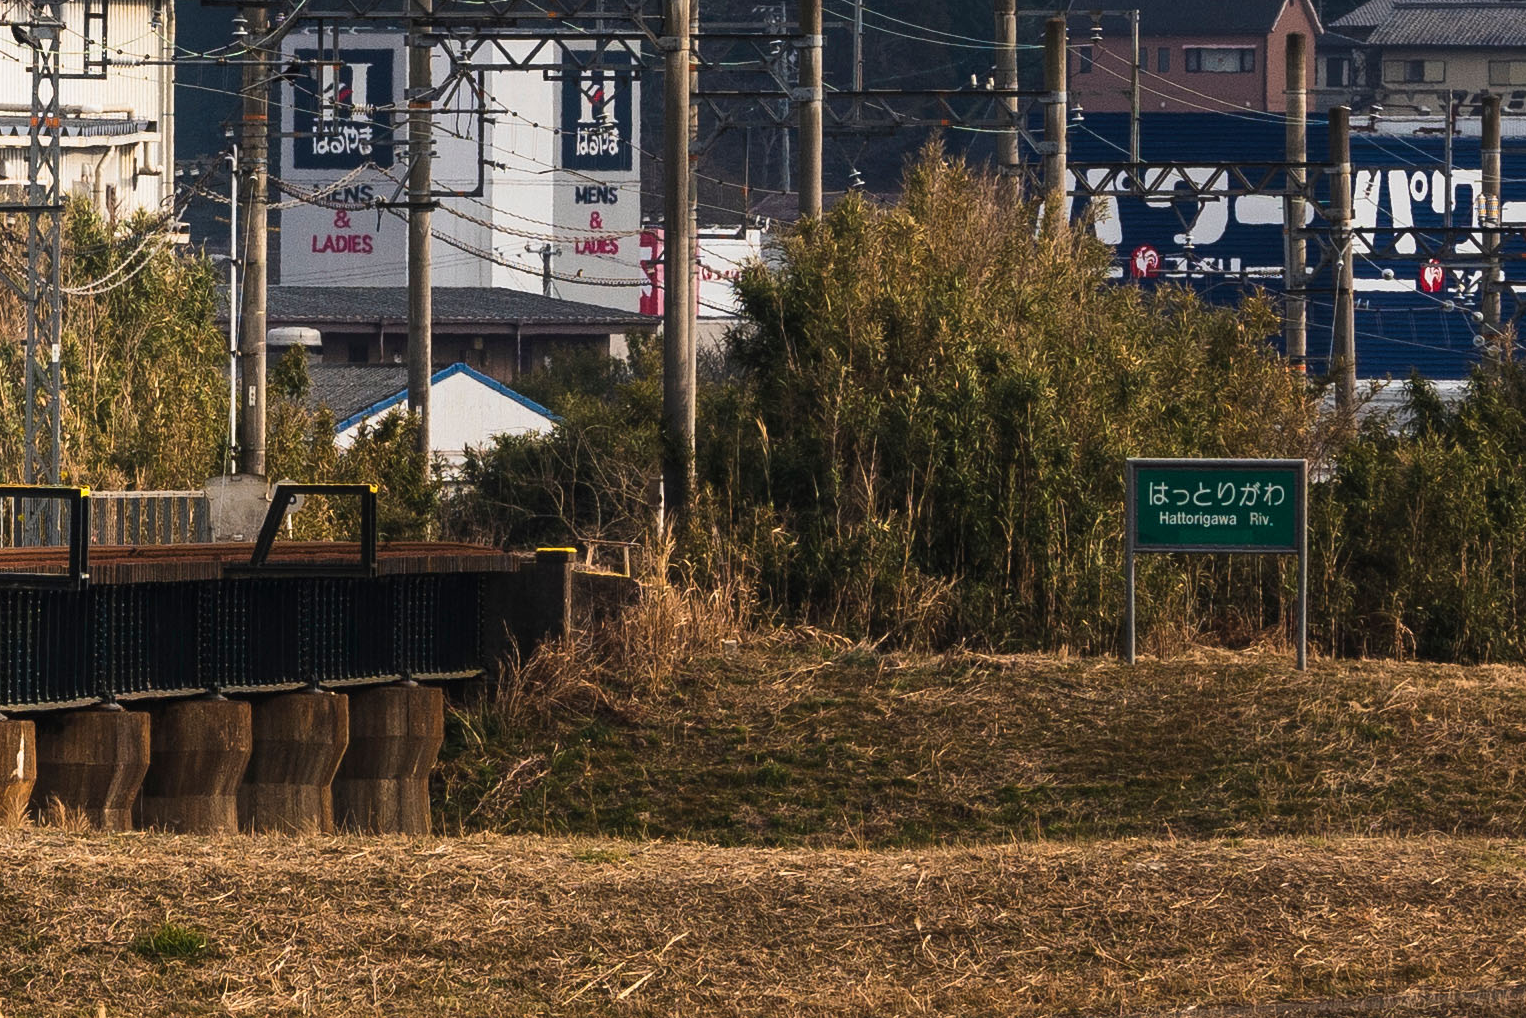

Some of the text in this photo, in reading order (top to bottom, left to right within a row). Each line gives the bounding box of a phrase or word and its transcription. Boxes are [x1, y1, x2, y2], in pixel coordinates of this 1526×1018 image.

[312, 125, 373, 155] はるやま
[575, 186, 618, 205] MENS
[334, 209, 350, 228] &
[589, 210, 604, 230] &
[311, 235, 373, 254] LADIES
[575, 236, 619, 255] LADIES
[1149, 481, 1285, 507] はっとりがわ
[1159, 511, 1274, 528] Hattorigawa Riv.
